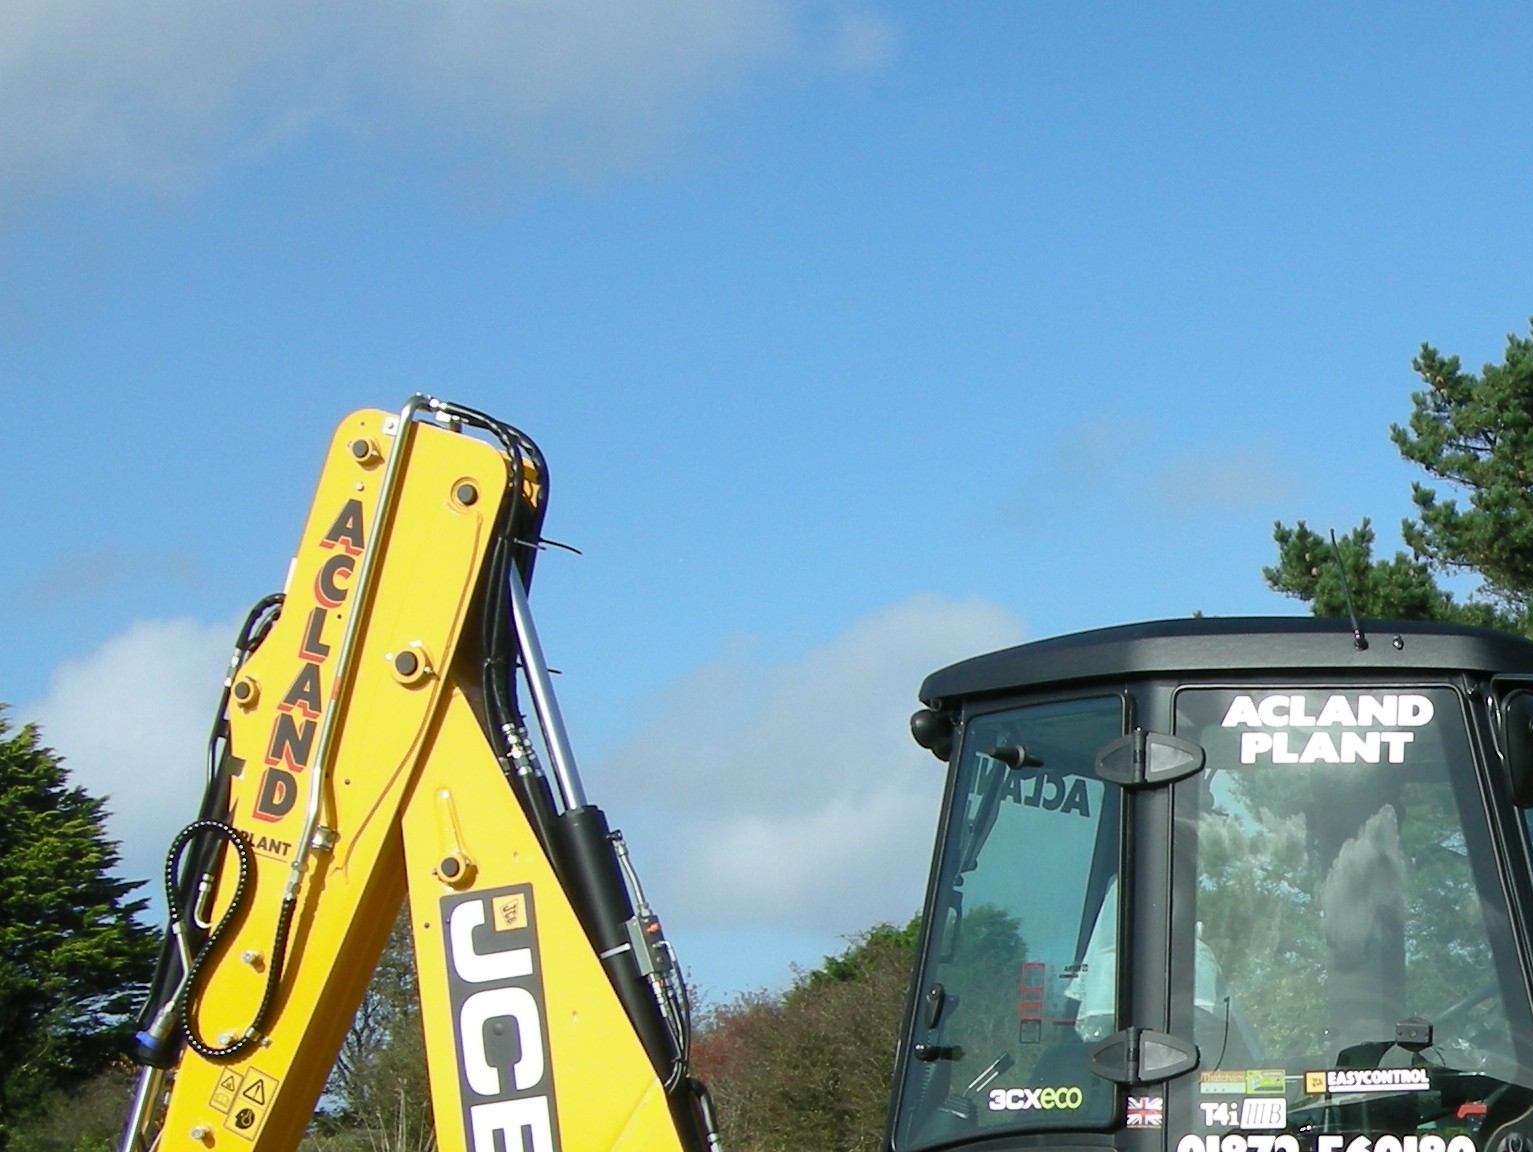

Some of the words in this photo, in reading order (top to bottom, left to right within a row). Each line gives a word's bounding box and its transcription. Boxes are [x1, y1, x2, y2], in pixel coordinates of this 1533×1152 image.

[251, 498, 364, 824] ACLAND
[1221, 695, 1434, 727] ACLAND
[1241, 732, 1414, 764] PLANT
[1327, 1069, 1430, 1085] EASYCONTROL
[989, 1087, 1082, 1110] 3CXeco
[1200, 1102, 1239, 1126] T4i
